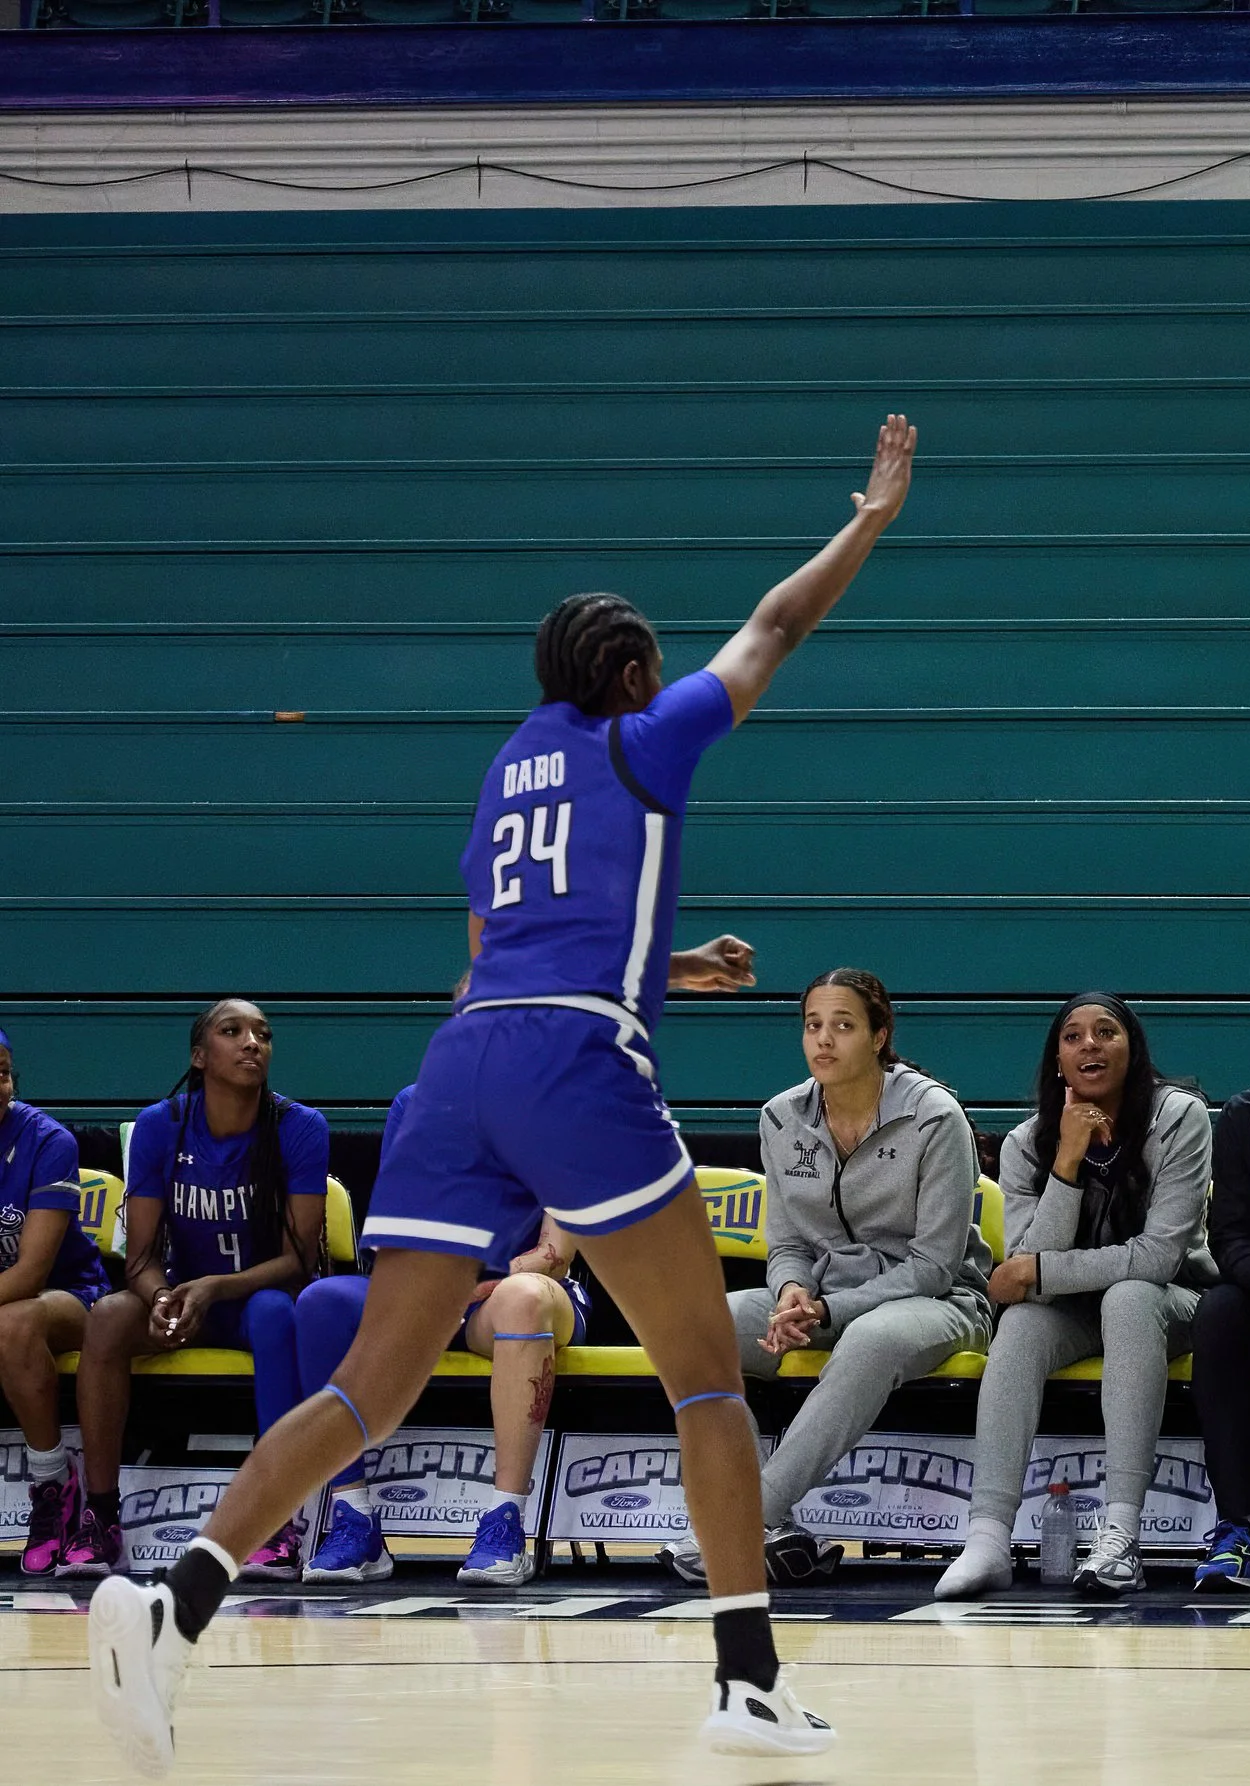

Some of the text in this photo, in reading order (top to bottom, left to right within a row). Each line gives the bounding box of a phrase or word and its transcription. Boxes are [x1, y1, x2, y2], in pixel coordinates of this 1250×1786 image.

[503, 751, 565, 799] DABO
[491, 802, 572, 910] 24
[174, 1182, 258, 1221] HAMPT
[217, 1233, 242, 1272] 4
[564, 1448, 682, 1498] CAPI
[823, 1446, 975, 1502] APITAL
[1022, 1450, 1212, 1504] CAPAL
[386, 1486, 419, 1501] Ford
[610, 1495, 642, 1509] Ford
[830, 1492, 862, 1506] Ford
[161, 1527, 193, 1541] Ford
[580, 1512, 690, 1531] WILMING
[800, 1507, 959, 1530] WILMINGTON
